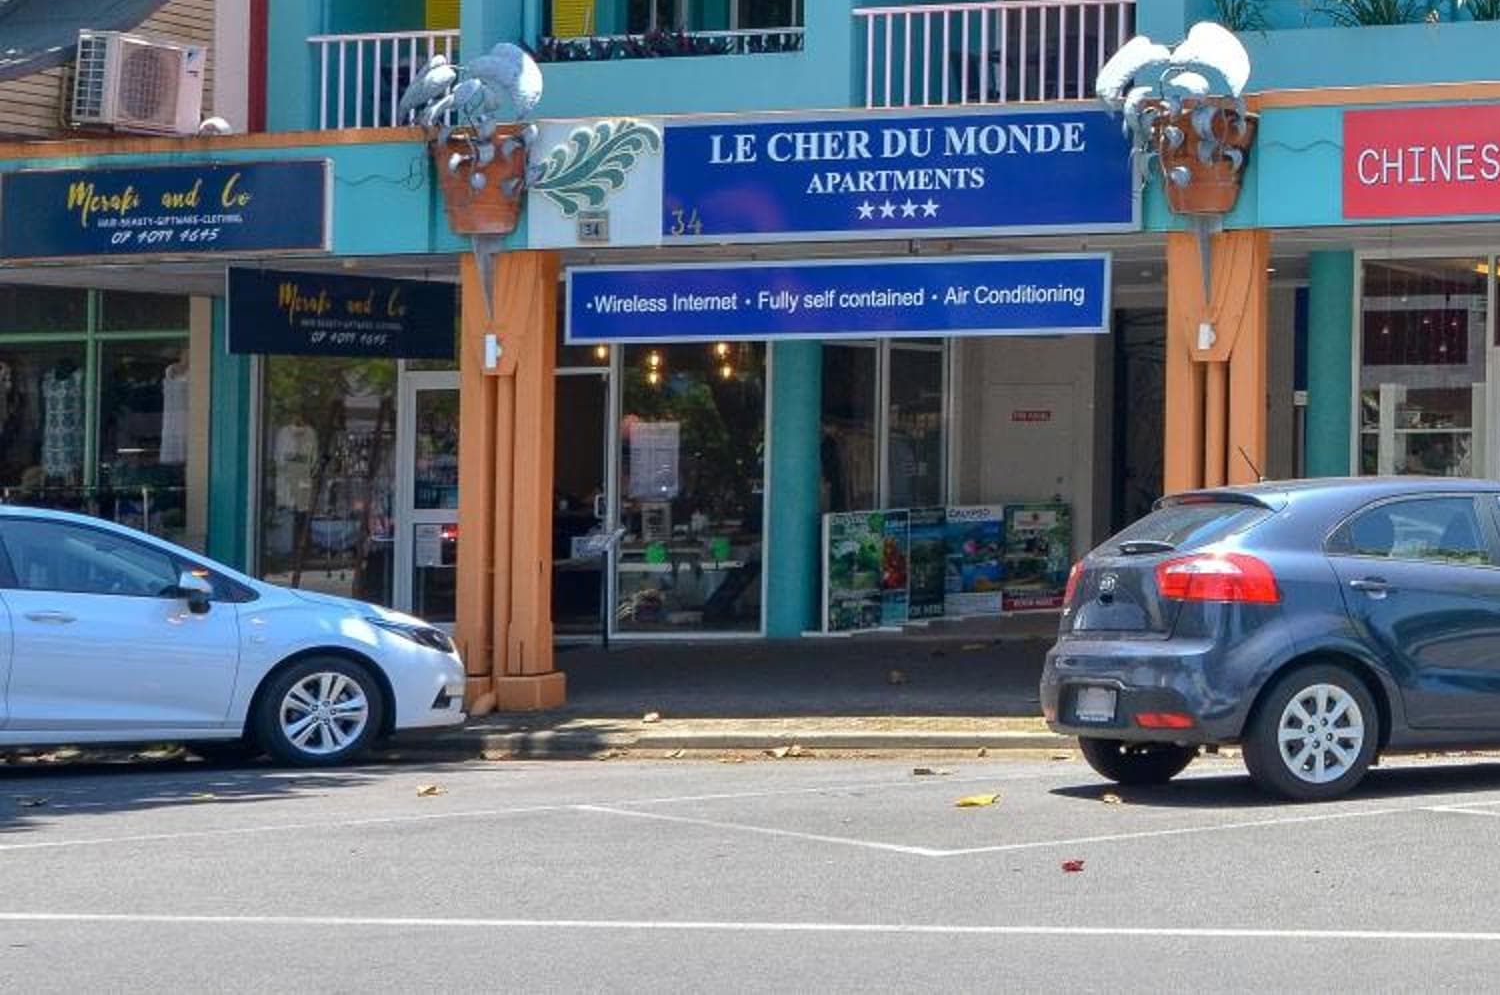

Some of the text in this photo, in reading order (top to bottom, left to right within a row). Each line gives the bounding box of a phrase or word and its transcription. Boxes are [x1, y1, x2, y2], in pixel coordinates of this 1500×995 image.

[708, 122, 1087, 164] LE CHER DU MONDE
[162, 178, 203, 208] and
[222, 173, 250, 207] Co
[806, 167, 985, 194] APARTMENTS
[671, 209, 703, 237] 34
[594, 284, 1085, 314] Wireless Internet Fully self contained Air Conditioning
